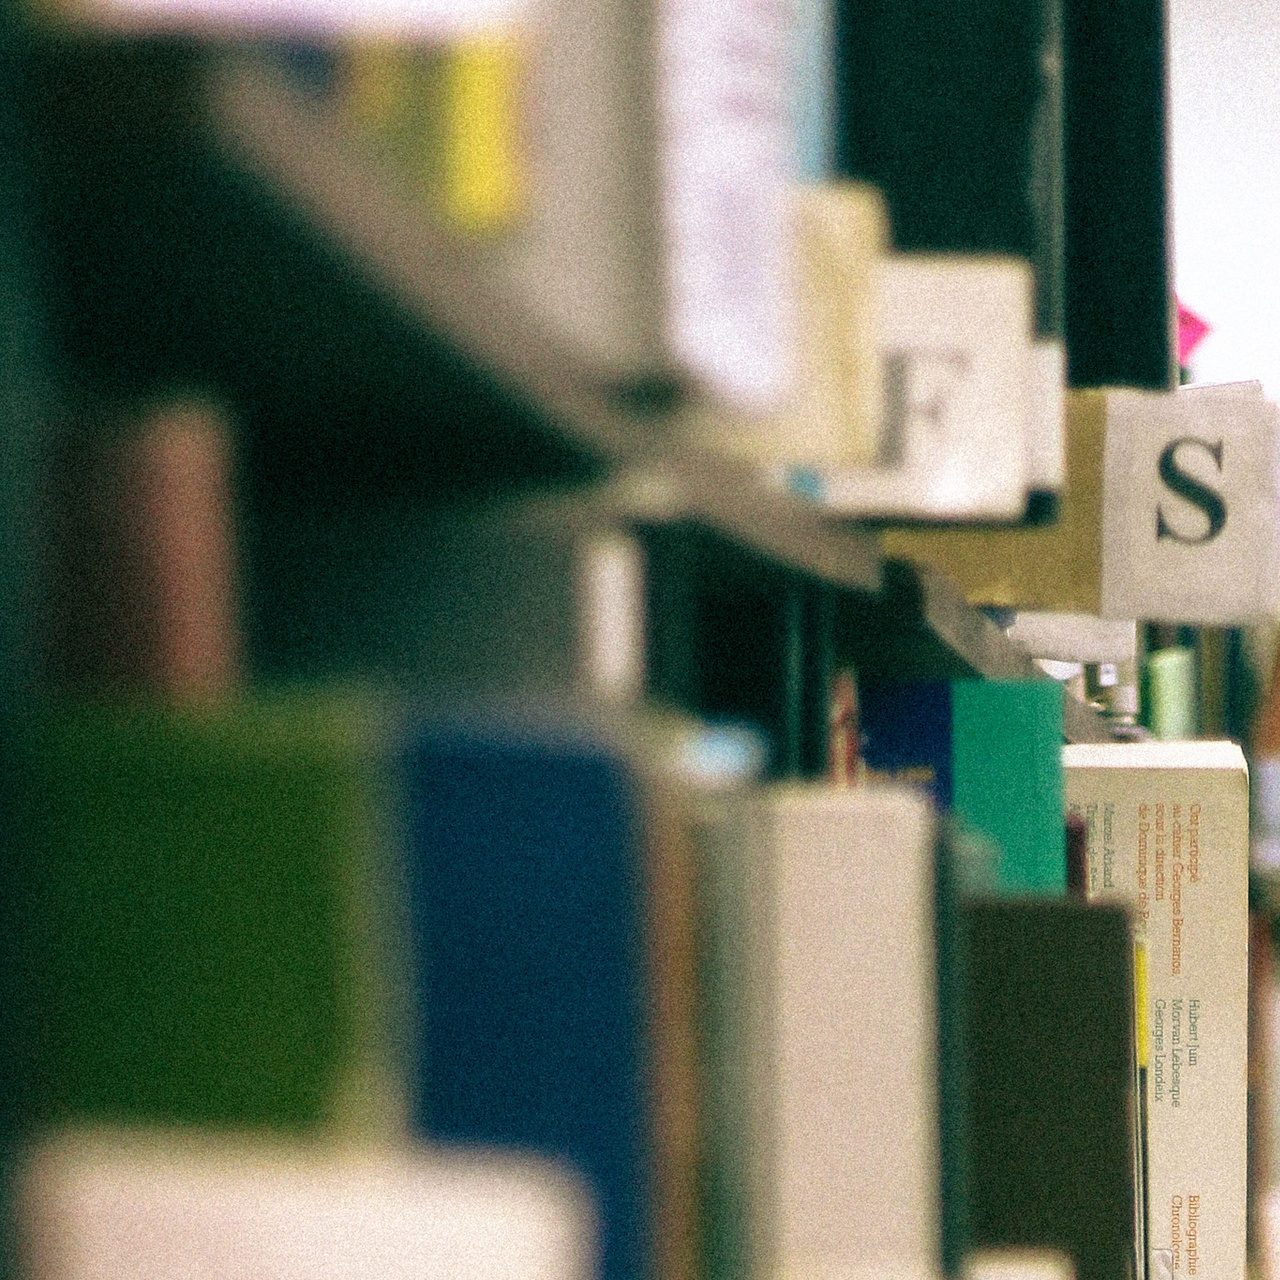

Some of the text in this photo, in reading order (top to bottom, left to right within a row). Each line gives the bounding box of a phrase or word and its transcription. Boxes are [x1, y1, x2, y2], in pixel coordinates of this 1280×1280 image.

[1155, 435, 1228, 546] S
[1152, 998, 1167, 1102] Georges Londeix
[1169, 998, 1184, 1108] Morvan Lebesque
[1188, 998, 1201, 1042] Hubert
[1183, 1194, 1201, 1276] Bibliographie
